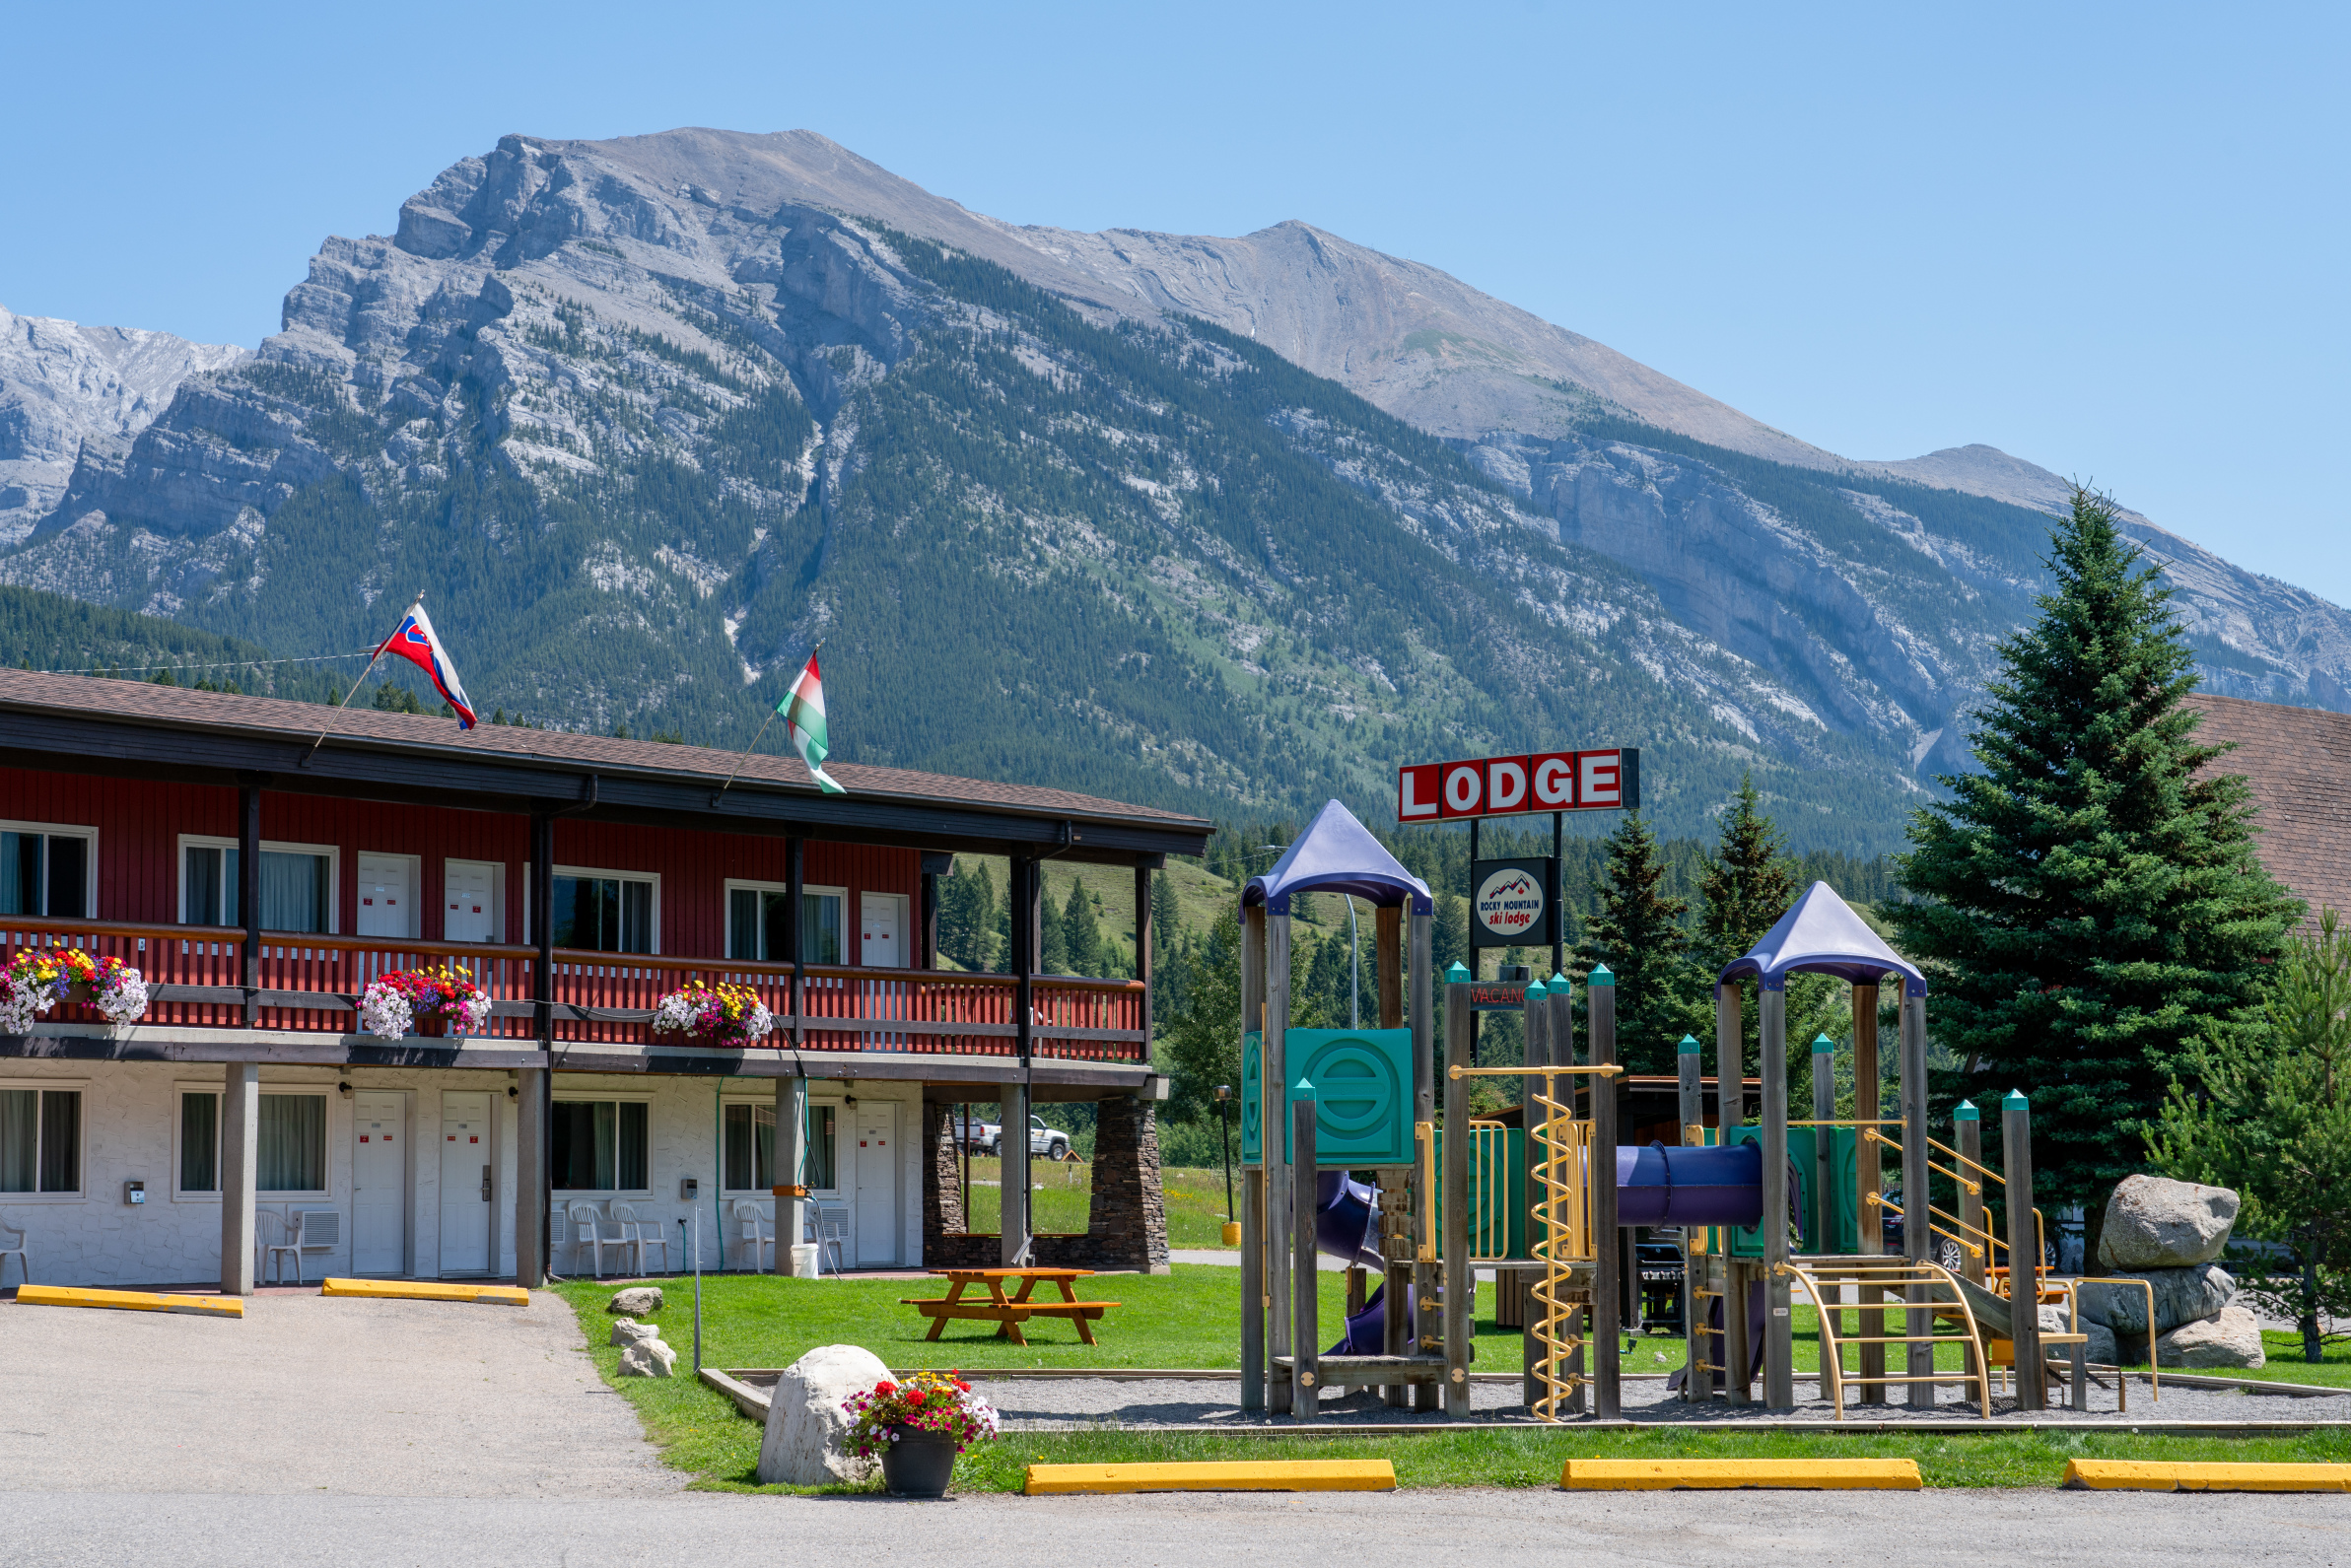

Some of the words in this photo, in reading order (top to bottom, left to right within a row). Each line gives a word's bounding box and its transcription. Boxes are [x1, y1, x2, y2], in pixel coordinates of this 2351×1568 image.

[1401, 755, 1620, 816] LODGE
[1480, 901, 1501, 912] ROCKY
[1503, 899, 1540, 911] MOUNTAIN
[1488, 911, 1503, 925] ski
[1504, 911, 1531, 927] lodge
